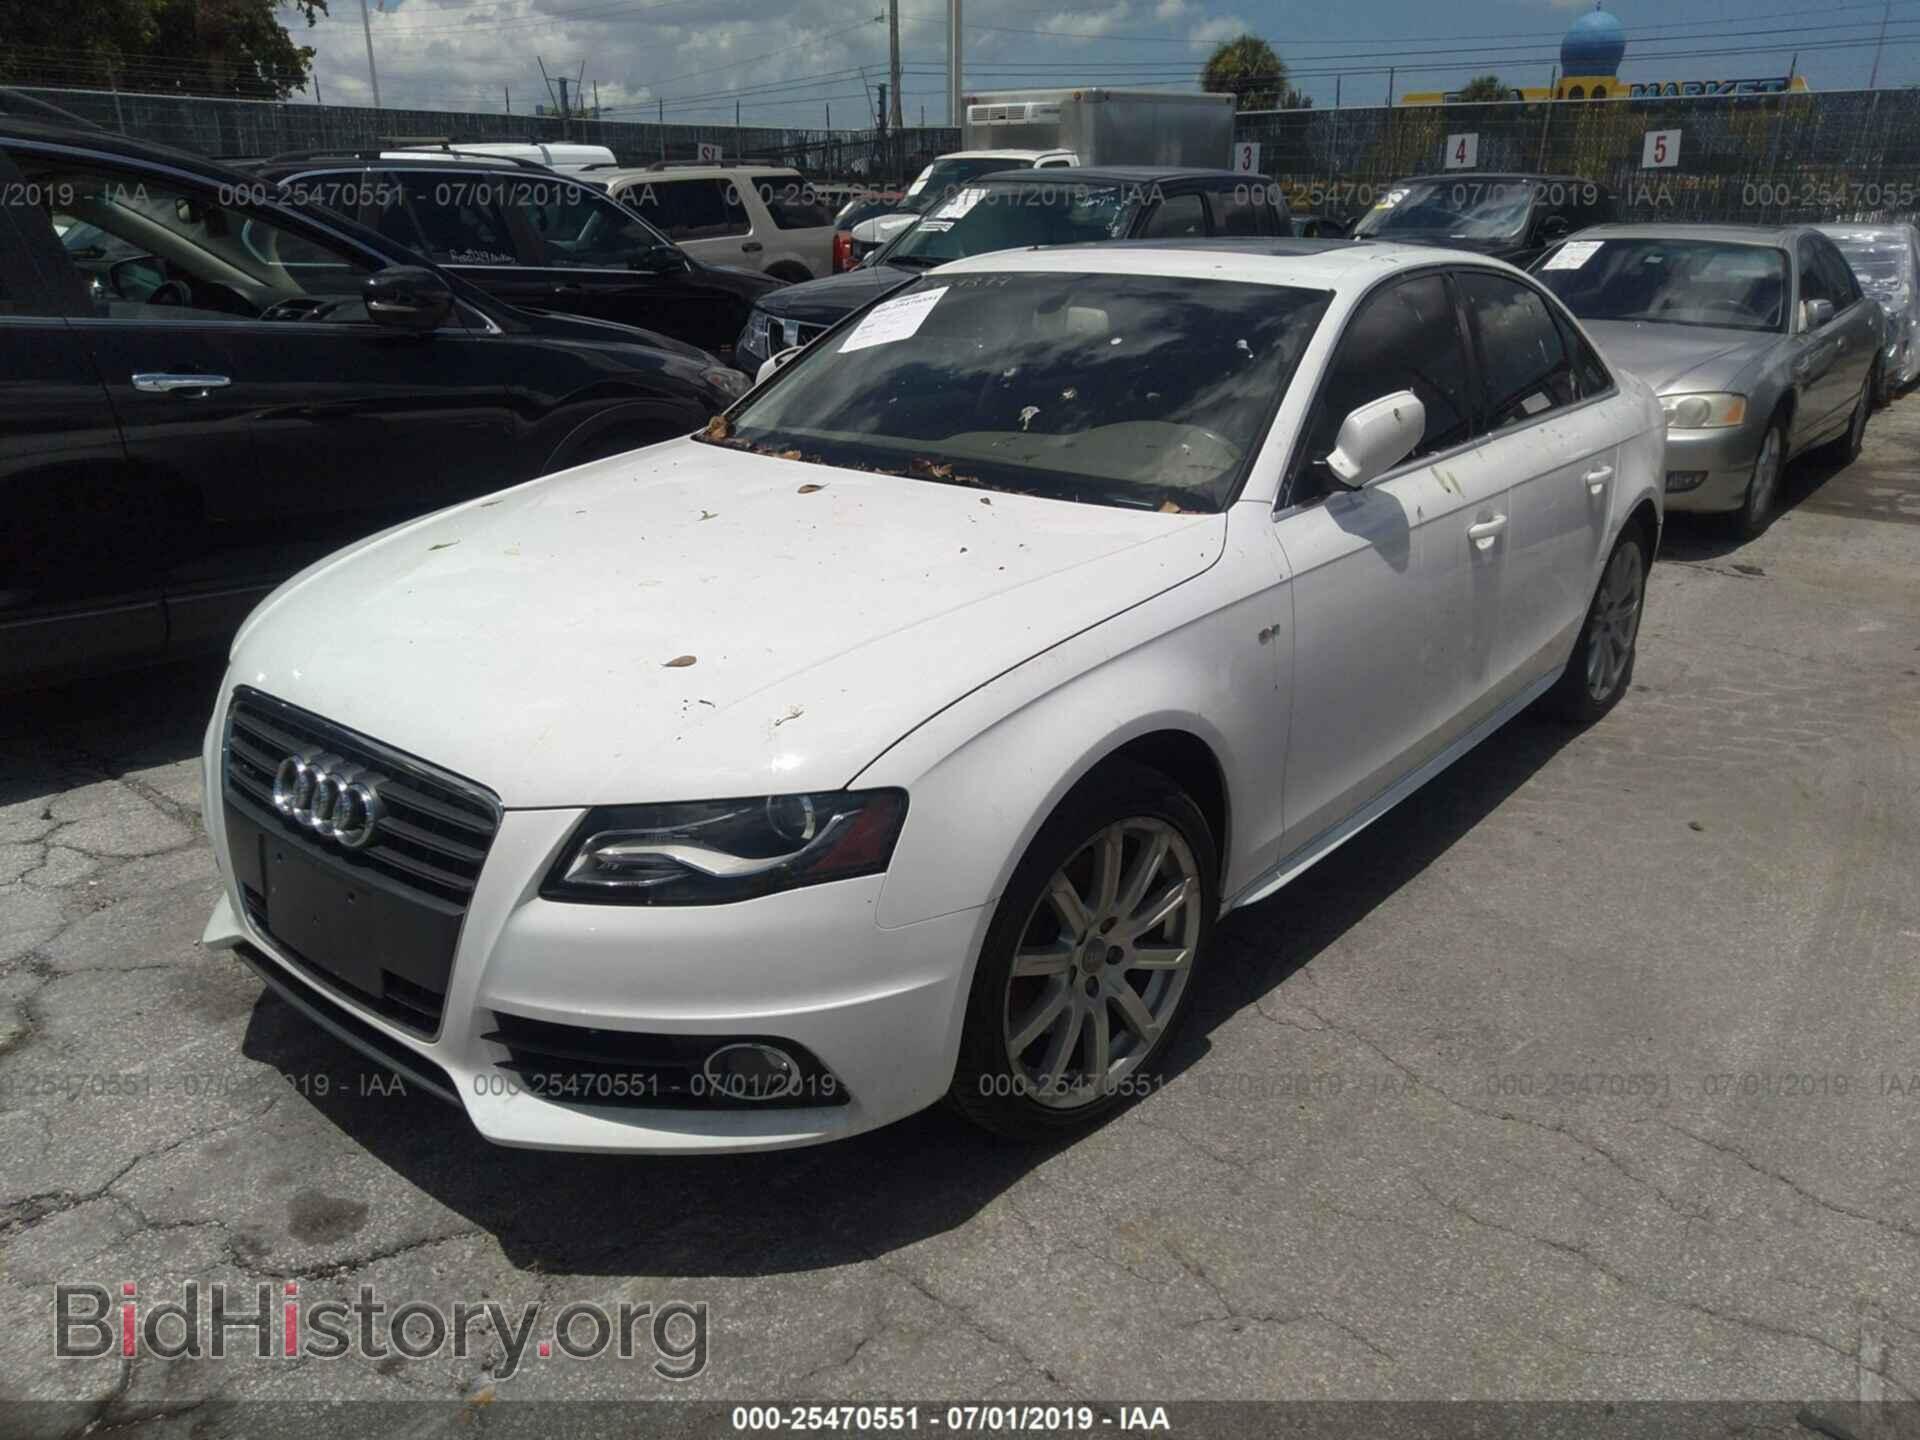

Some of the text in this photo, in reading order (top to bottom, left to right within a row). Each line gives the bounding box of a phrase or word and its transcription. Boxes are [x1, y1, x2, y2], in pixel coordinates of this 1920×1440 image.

[1242, 146, 1252, 170] 3
[1456, 139, 1467, 163] 4
[1654, 136, 1667, 163] 5
